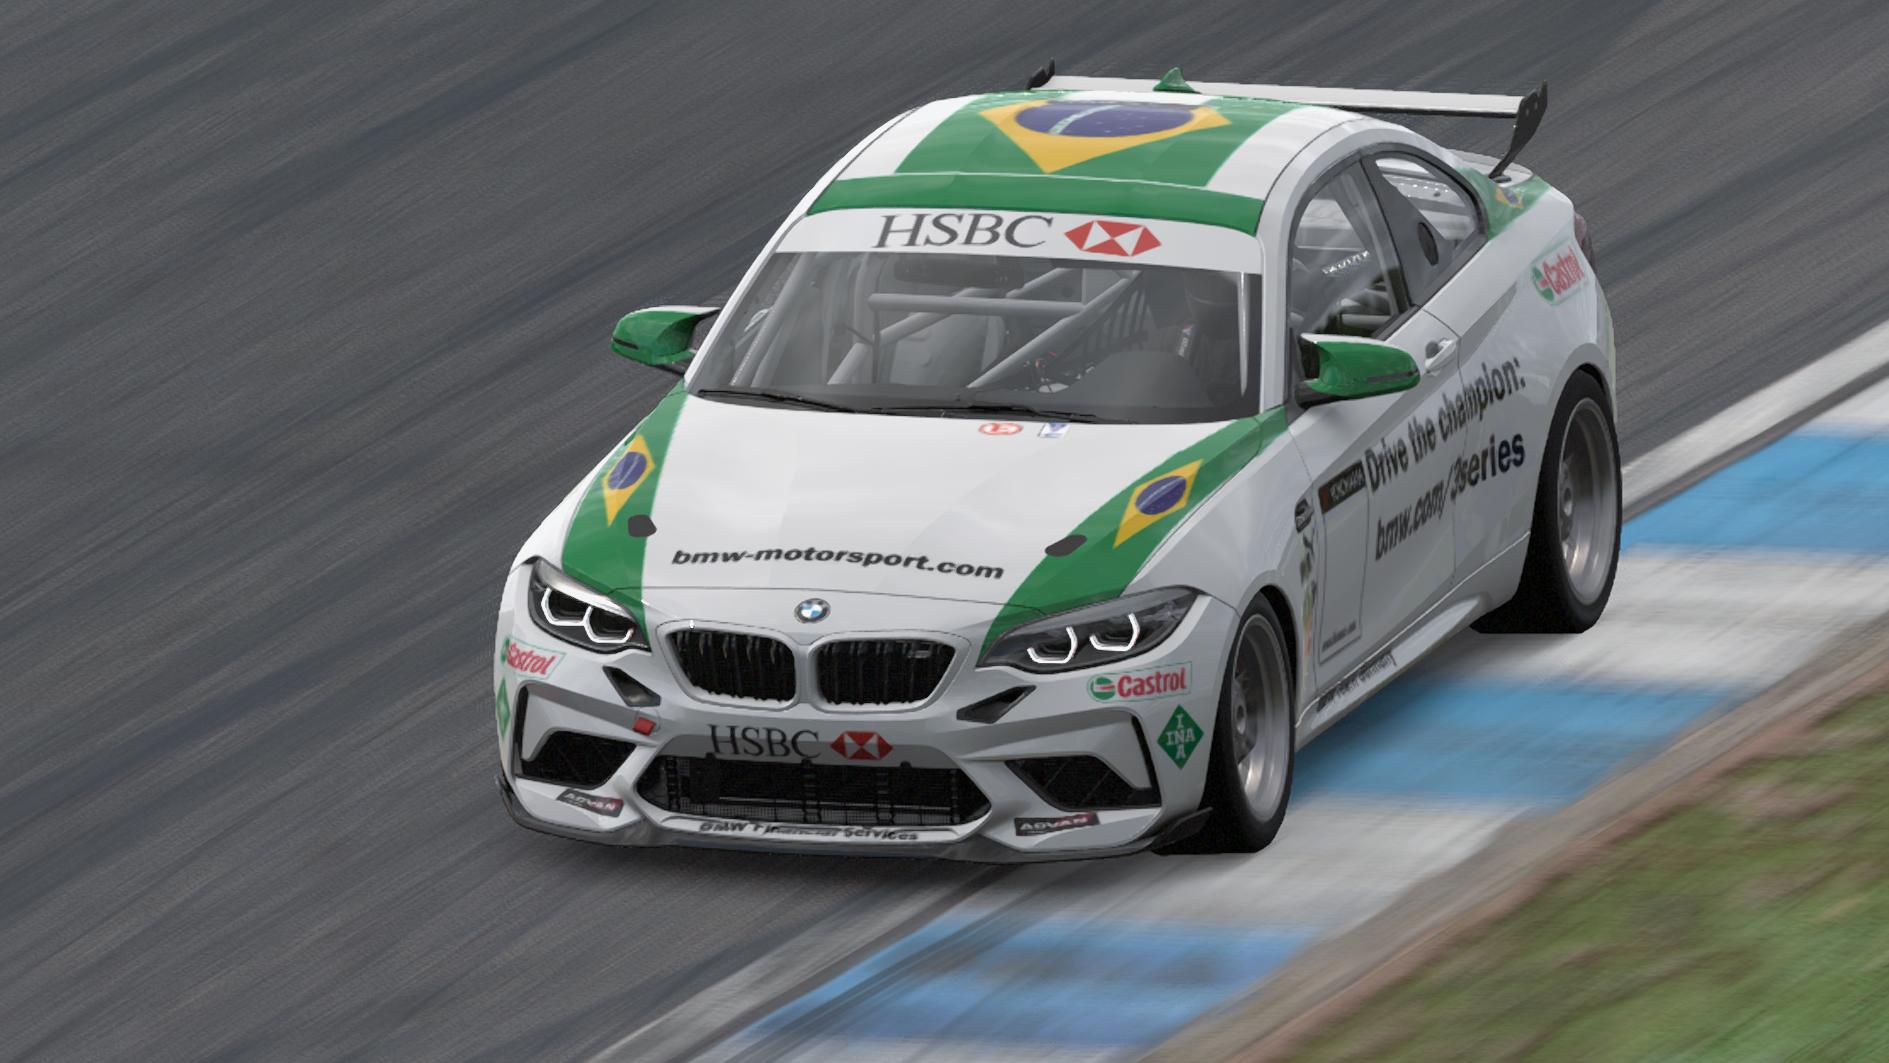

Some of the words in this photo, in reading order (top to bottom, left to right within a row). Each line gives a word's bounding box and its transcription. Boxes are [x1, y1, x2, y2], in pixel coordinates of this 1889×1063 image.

[871, 212, 1054, 249] HSBC
[1542, 245, 1584, 295] Castrol
[1365, 437, 1409, 491] Drive
[1408, 416, 1436, 464] the
[1439, 356, 1526, 443] champion:
[671, 547, 1004, 580] bmw-motorsport.com
[1117, 667, 1187, 698] Castrol
[707, 724, 822, 759] HSBC
[1166, 728, 1196, 746] INA
[1019, 817, 1089, 831] ADVAN
